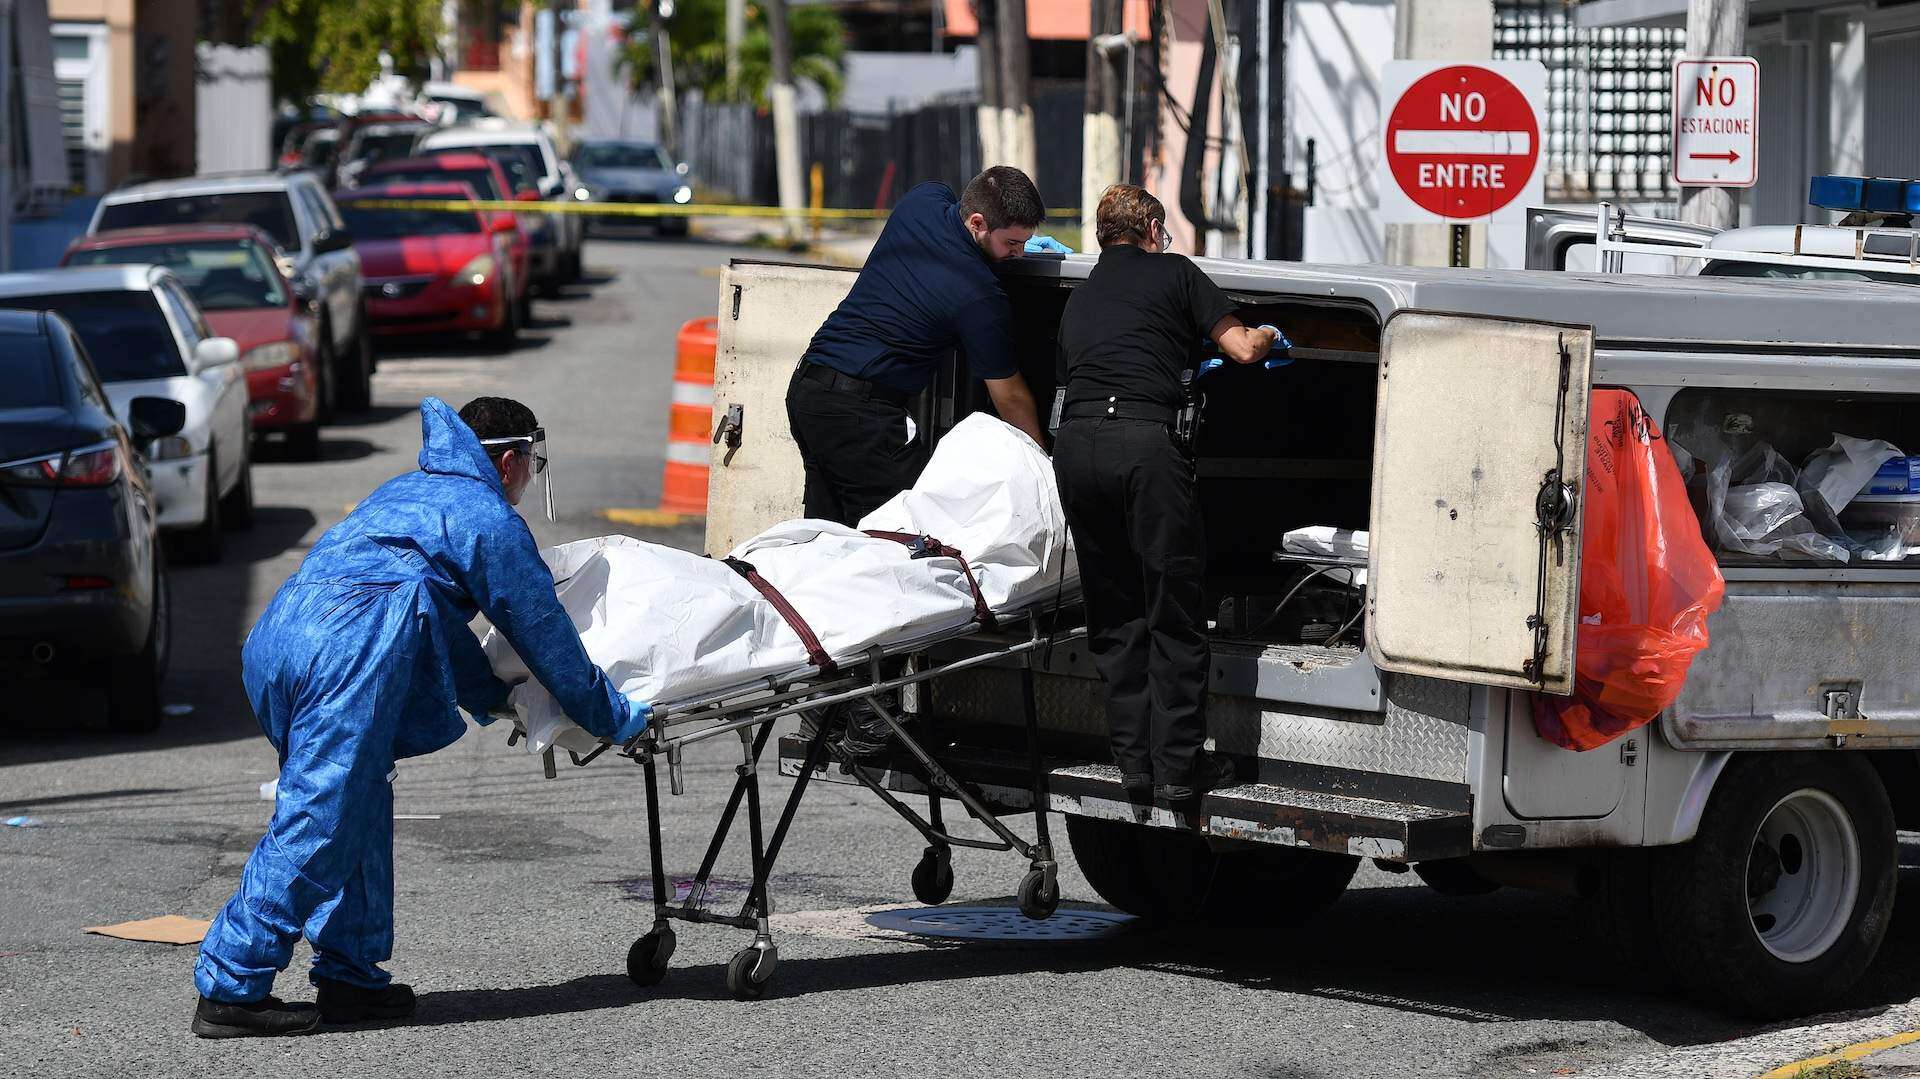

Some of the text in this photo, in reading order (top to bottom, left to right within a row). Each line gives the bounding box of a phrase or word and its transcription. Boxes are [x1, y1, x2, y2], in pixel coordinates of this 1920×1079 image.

[1696, 77, 1736, 108] NO
[1439, 91, 1487, 123] NO
[1681, 118, 1751, 135] ESTACIONE
[1418, 163, 1506, 189] ENTRE
